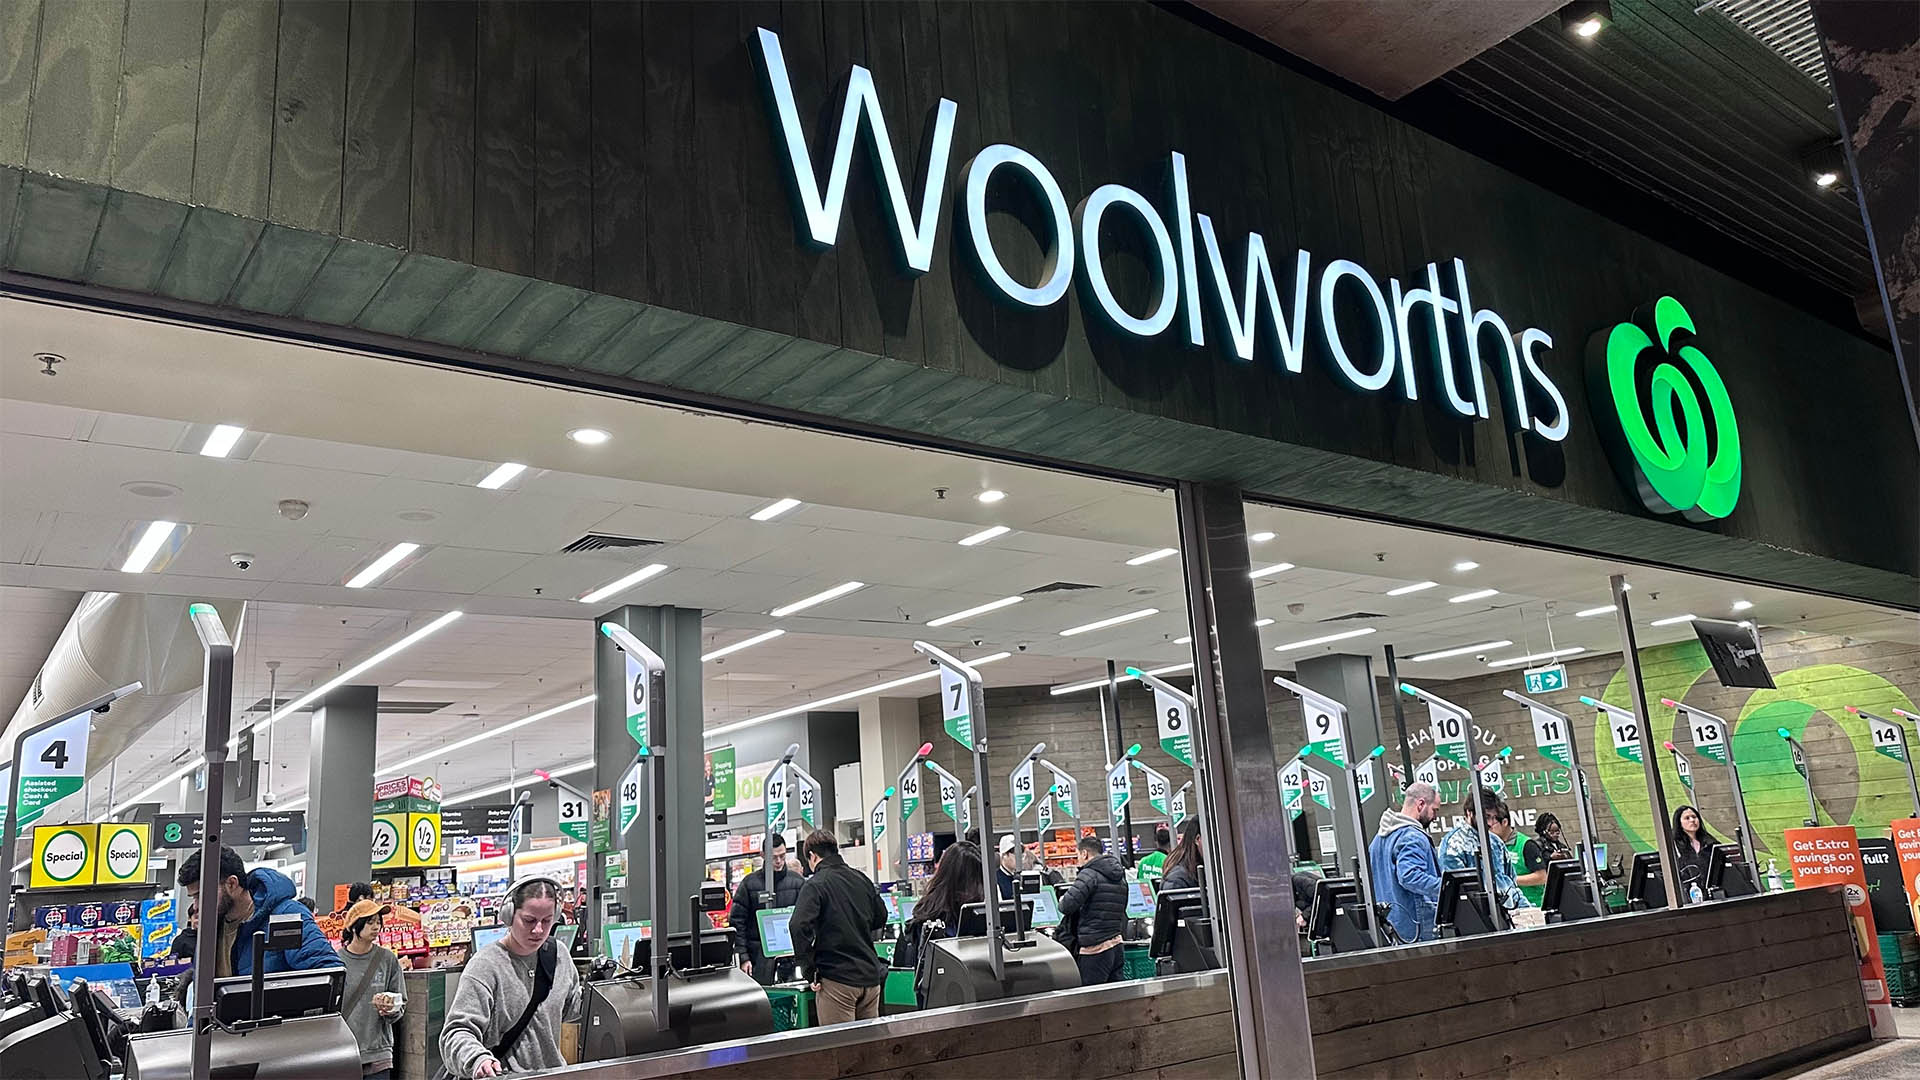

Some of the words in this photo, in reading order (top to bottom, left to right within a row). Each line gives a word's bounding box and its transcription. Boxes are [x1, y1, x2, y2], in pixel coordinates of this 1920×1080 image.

[757, 27, 1570, 442] Woolworths
[633, 673, 645, 705] 6
[950, 683, 962, 711] 7
[1167, 707, 1181, 730] 8
[1316, 714, 1330, 735] 9
[1436, 718, 1460, 739] 10
[1542, 721, 1560, 740] 11
[1616, 724, 1639, 742] 12
[1695, 725, 1718, 742] 13
[1875, 728, 1896, 742] 14
[41, 740, 69, 769] 4
[1679, 762, 1687, 773] 17
[1016, 776, 1031, 791] 45
[1112, 775, 1127, 789] 44
[1284, 774, 1299, 786] 42
[1357, 774, 1369, 785] 41
[1419, 772, 1434, 783] 40
[1484, 772, 1499, 782] 39
[379, 780, 407, 792] PRICES
[379, 787, 407, 797] DROPPED
[623, 783, 637, 800] 48
[770, 782, 783, 799] 47
[903, 778, 917, 794] 46
[942, 786, 955, 800] 33
[1057, 784, 1071, 798] 34
[1151, 783, 1165, 796] 35
[1312, 780, 1325, 792] 37
[801, 789, 813, 805] 32
[562, 801, 582, 818] 31
[1040, 806, 1050, 817] 25
[1173, 802, 1183, 811] 23
[874, 812, 884, 824] 27
[164, 822, 182, 842] 8
[372, 829, 390, 847] /2
[418, 826, 432, 845] 1/2
[1898, 829, 1916, 839] Get
[1793, 840, 1814, 851] Get
[1815, 840, 1849, 850] Extra
[46, 851, 84, 864] Special
[110, 849, 139, 861] Special
[1793, 853, 1836, 864] savings
[1838, 852, 1855, 861] on
[1862, 854, 1889, 865] full?
[1797, 866, 1821, 877] your
[1824, 864, 1855, 875] shop
[1846, 888, 1860, 896] 2x
